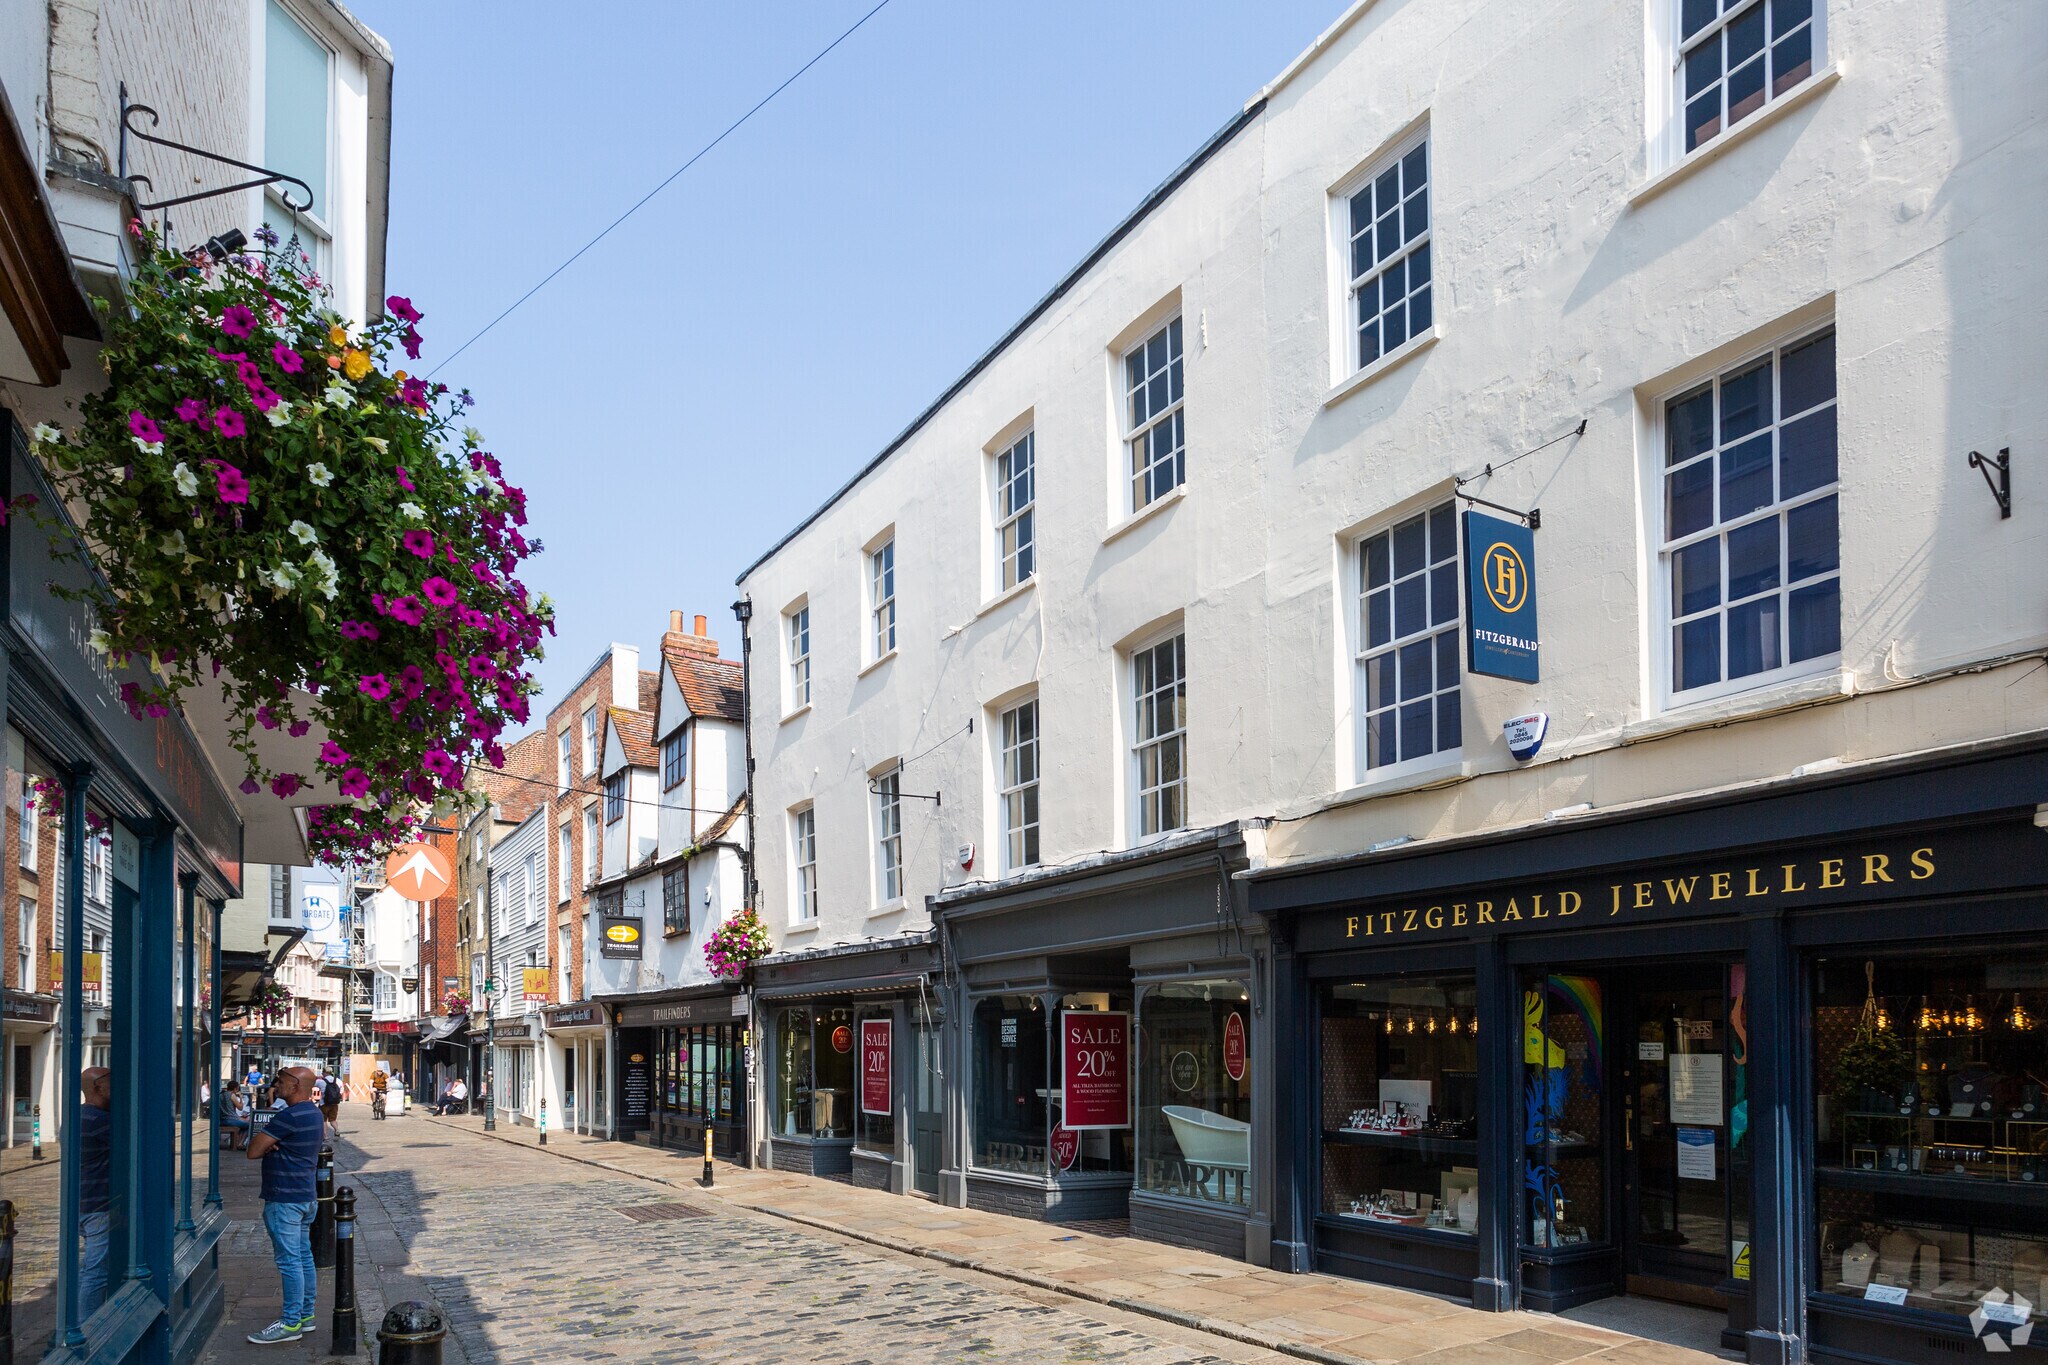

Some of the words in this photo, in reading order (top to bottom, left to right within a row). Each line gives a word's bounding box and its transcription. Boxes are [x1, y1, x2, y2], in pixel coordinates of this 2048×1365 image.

[1475, 629, 1538, 651] FITZGERALD
[1514, 731, 1528, 739] 0845
[1346, 891, 1582, 938] FITZGERALD
[1610, 848, 1936, 916] JEWELLERS
[653, 1006, 691, 1021] TRAILFINDERS
[1001, 1025, 1017, 1035] DESIGN
[1071, 1028, 1121, 1044] SALE
[1228, 1024, 1241, 1036] SALE
[866, 1033, 888, 1047] SALE
[1001, 1034, 1017, 1043] SERVICE
[869, 1050, 886, 1073] 20%
[1077, 1050, 1115, 1078] 20%
[1105, 1070, 1117, 1078] OFF
[254, 1113, 276, 1123] LUNC
[986, 1141, 1061, 1177] FIRED
